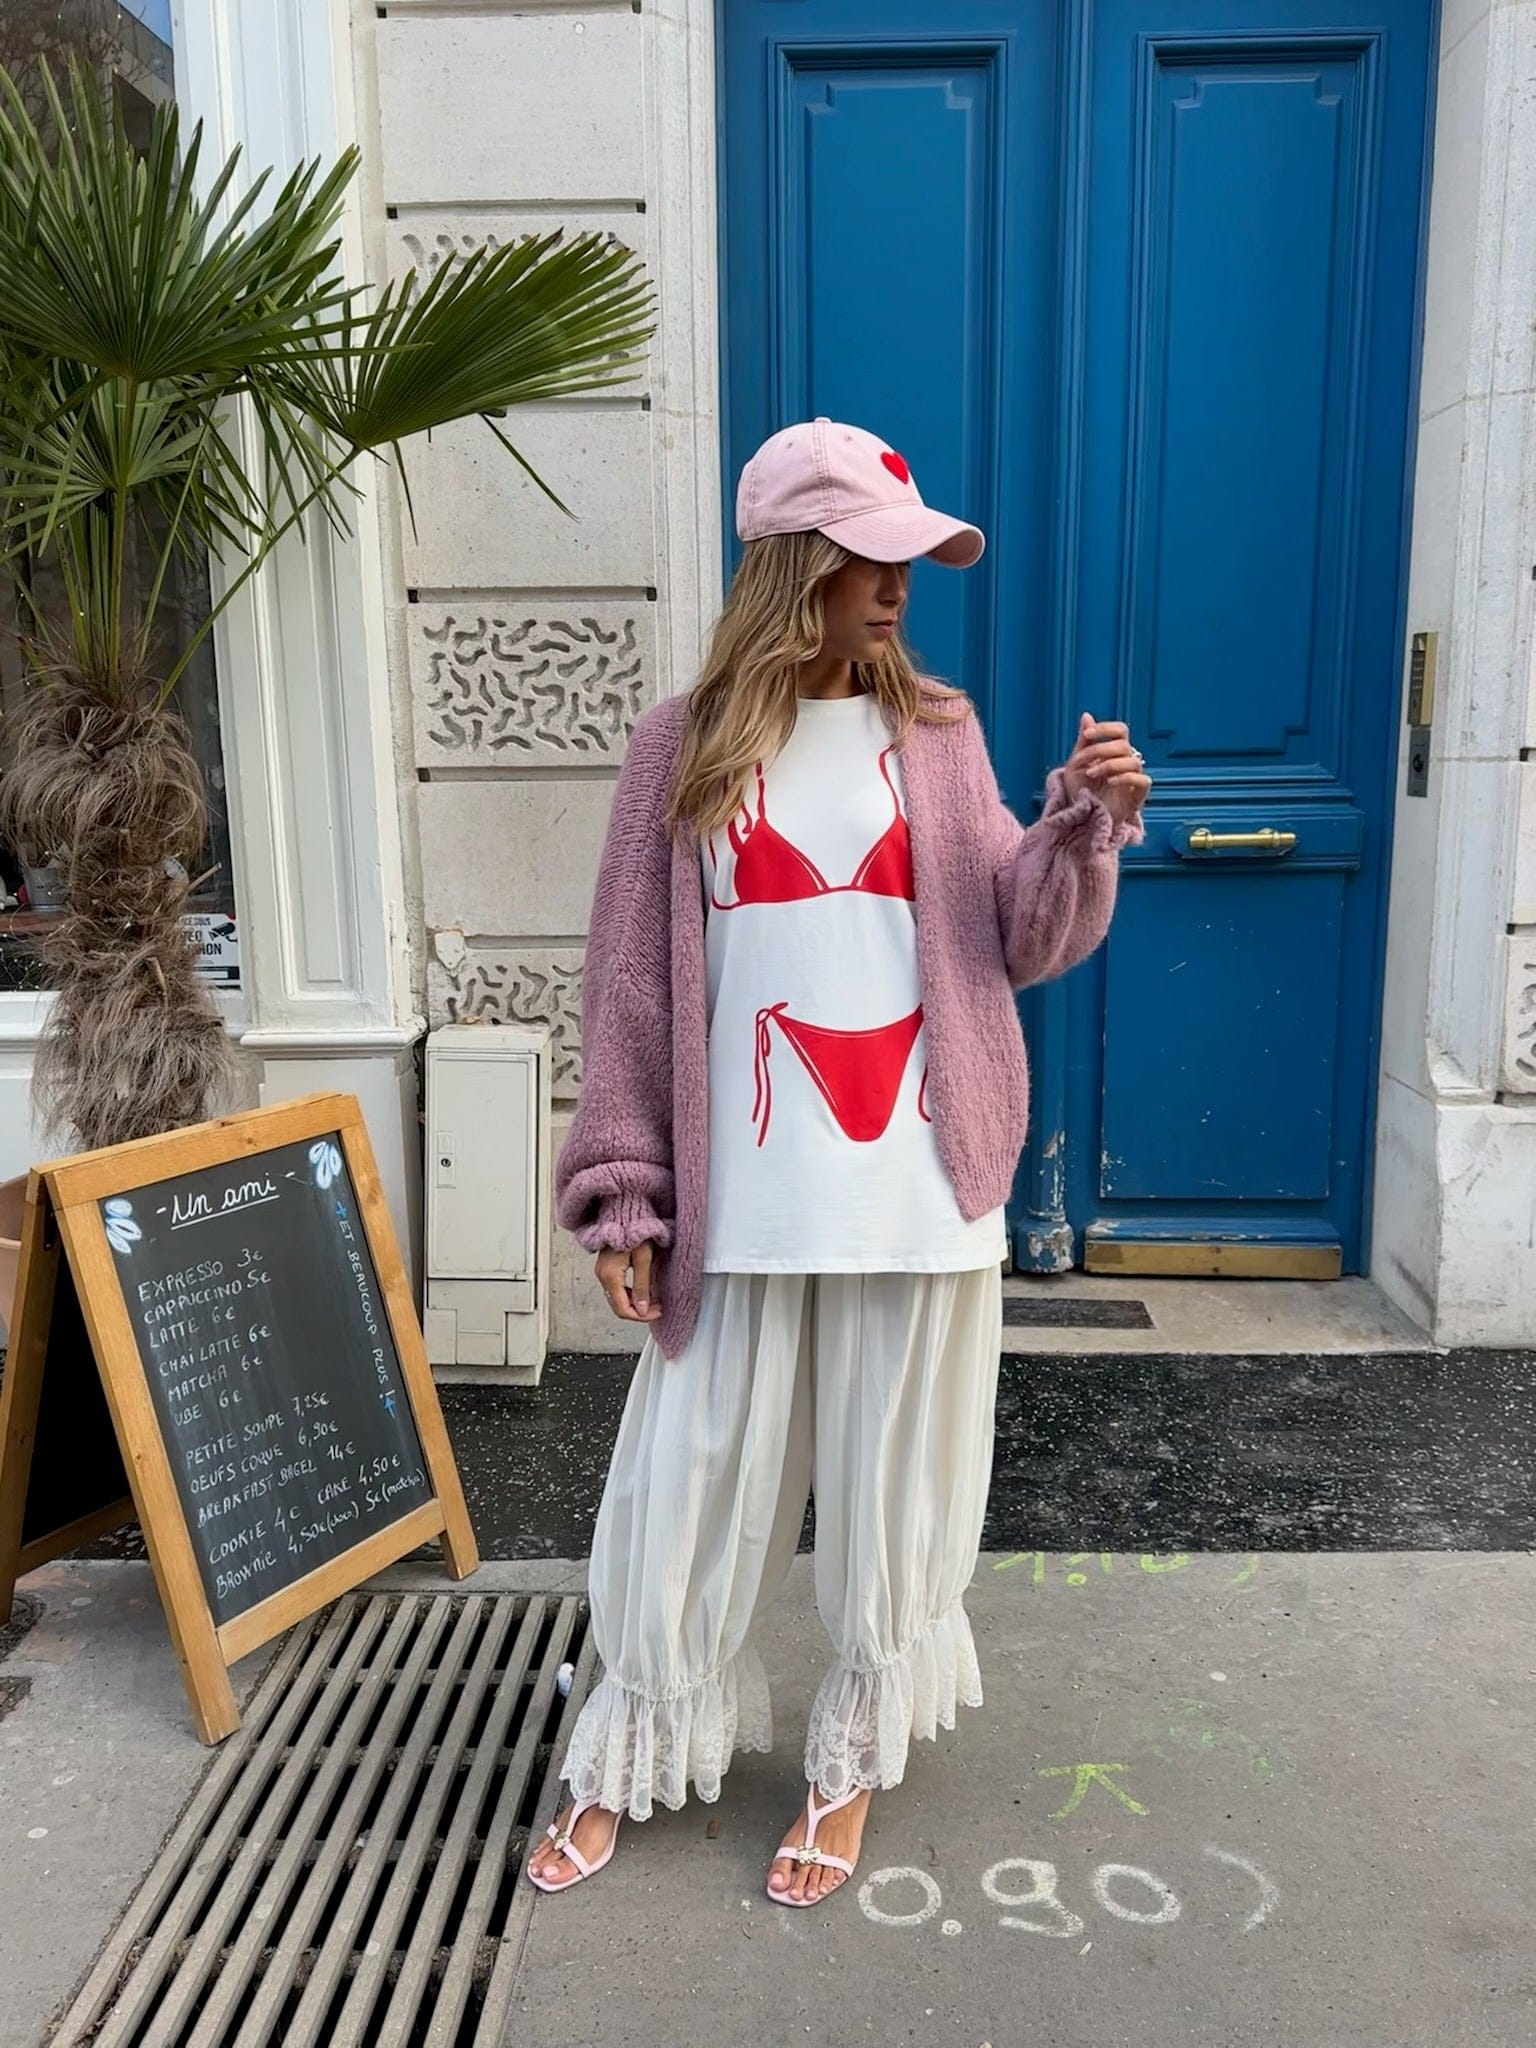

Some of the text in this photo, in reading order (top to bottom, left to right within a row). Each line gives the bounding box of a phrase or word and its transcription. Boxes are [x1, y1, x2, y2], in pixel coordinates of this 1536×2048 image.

[221, 1172, 277, 1209] ami
[138, 1261, 224, 1302] EXPRESSO
[338, 1220, 355, 1242] ET
[347, 1249, 378, 1336] BEAUCOUP
[372, 1348, 389, 1384] PLUS
[150, 1317, 199, 1349] LATTE
[200, 1334, 242, 1361] LATTE
[168, 1364, 228, 1403] MATCHA
[174, 1403, 202, 1426] UBE
[243, 1412, 285, 1442] SOUPE
[190, 1462, 236, 1494] OEUFS
[241, 1443, 283, 1474] COQUE
[197, 1441, 357, 1529] BREAKFAST BAGEL 14€
[317, 1476, 352, 1505] CAKE
[359, 1454, 400, 1486] 4,50€
